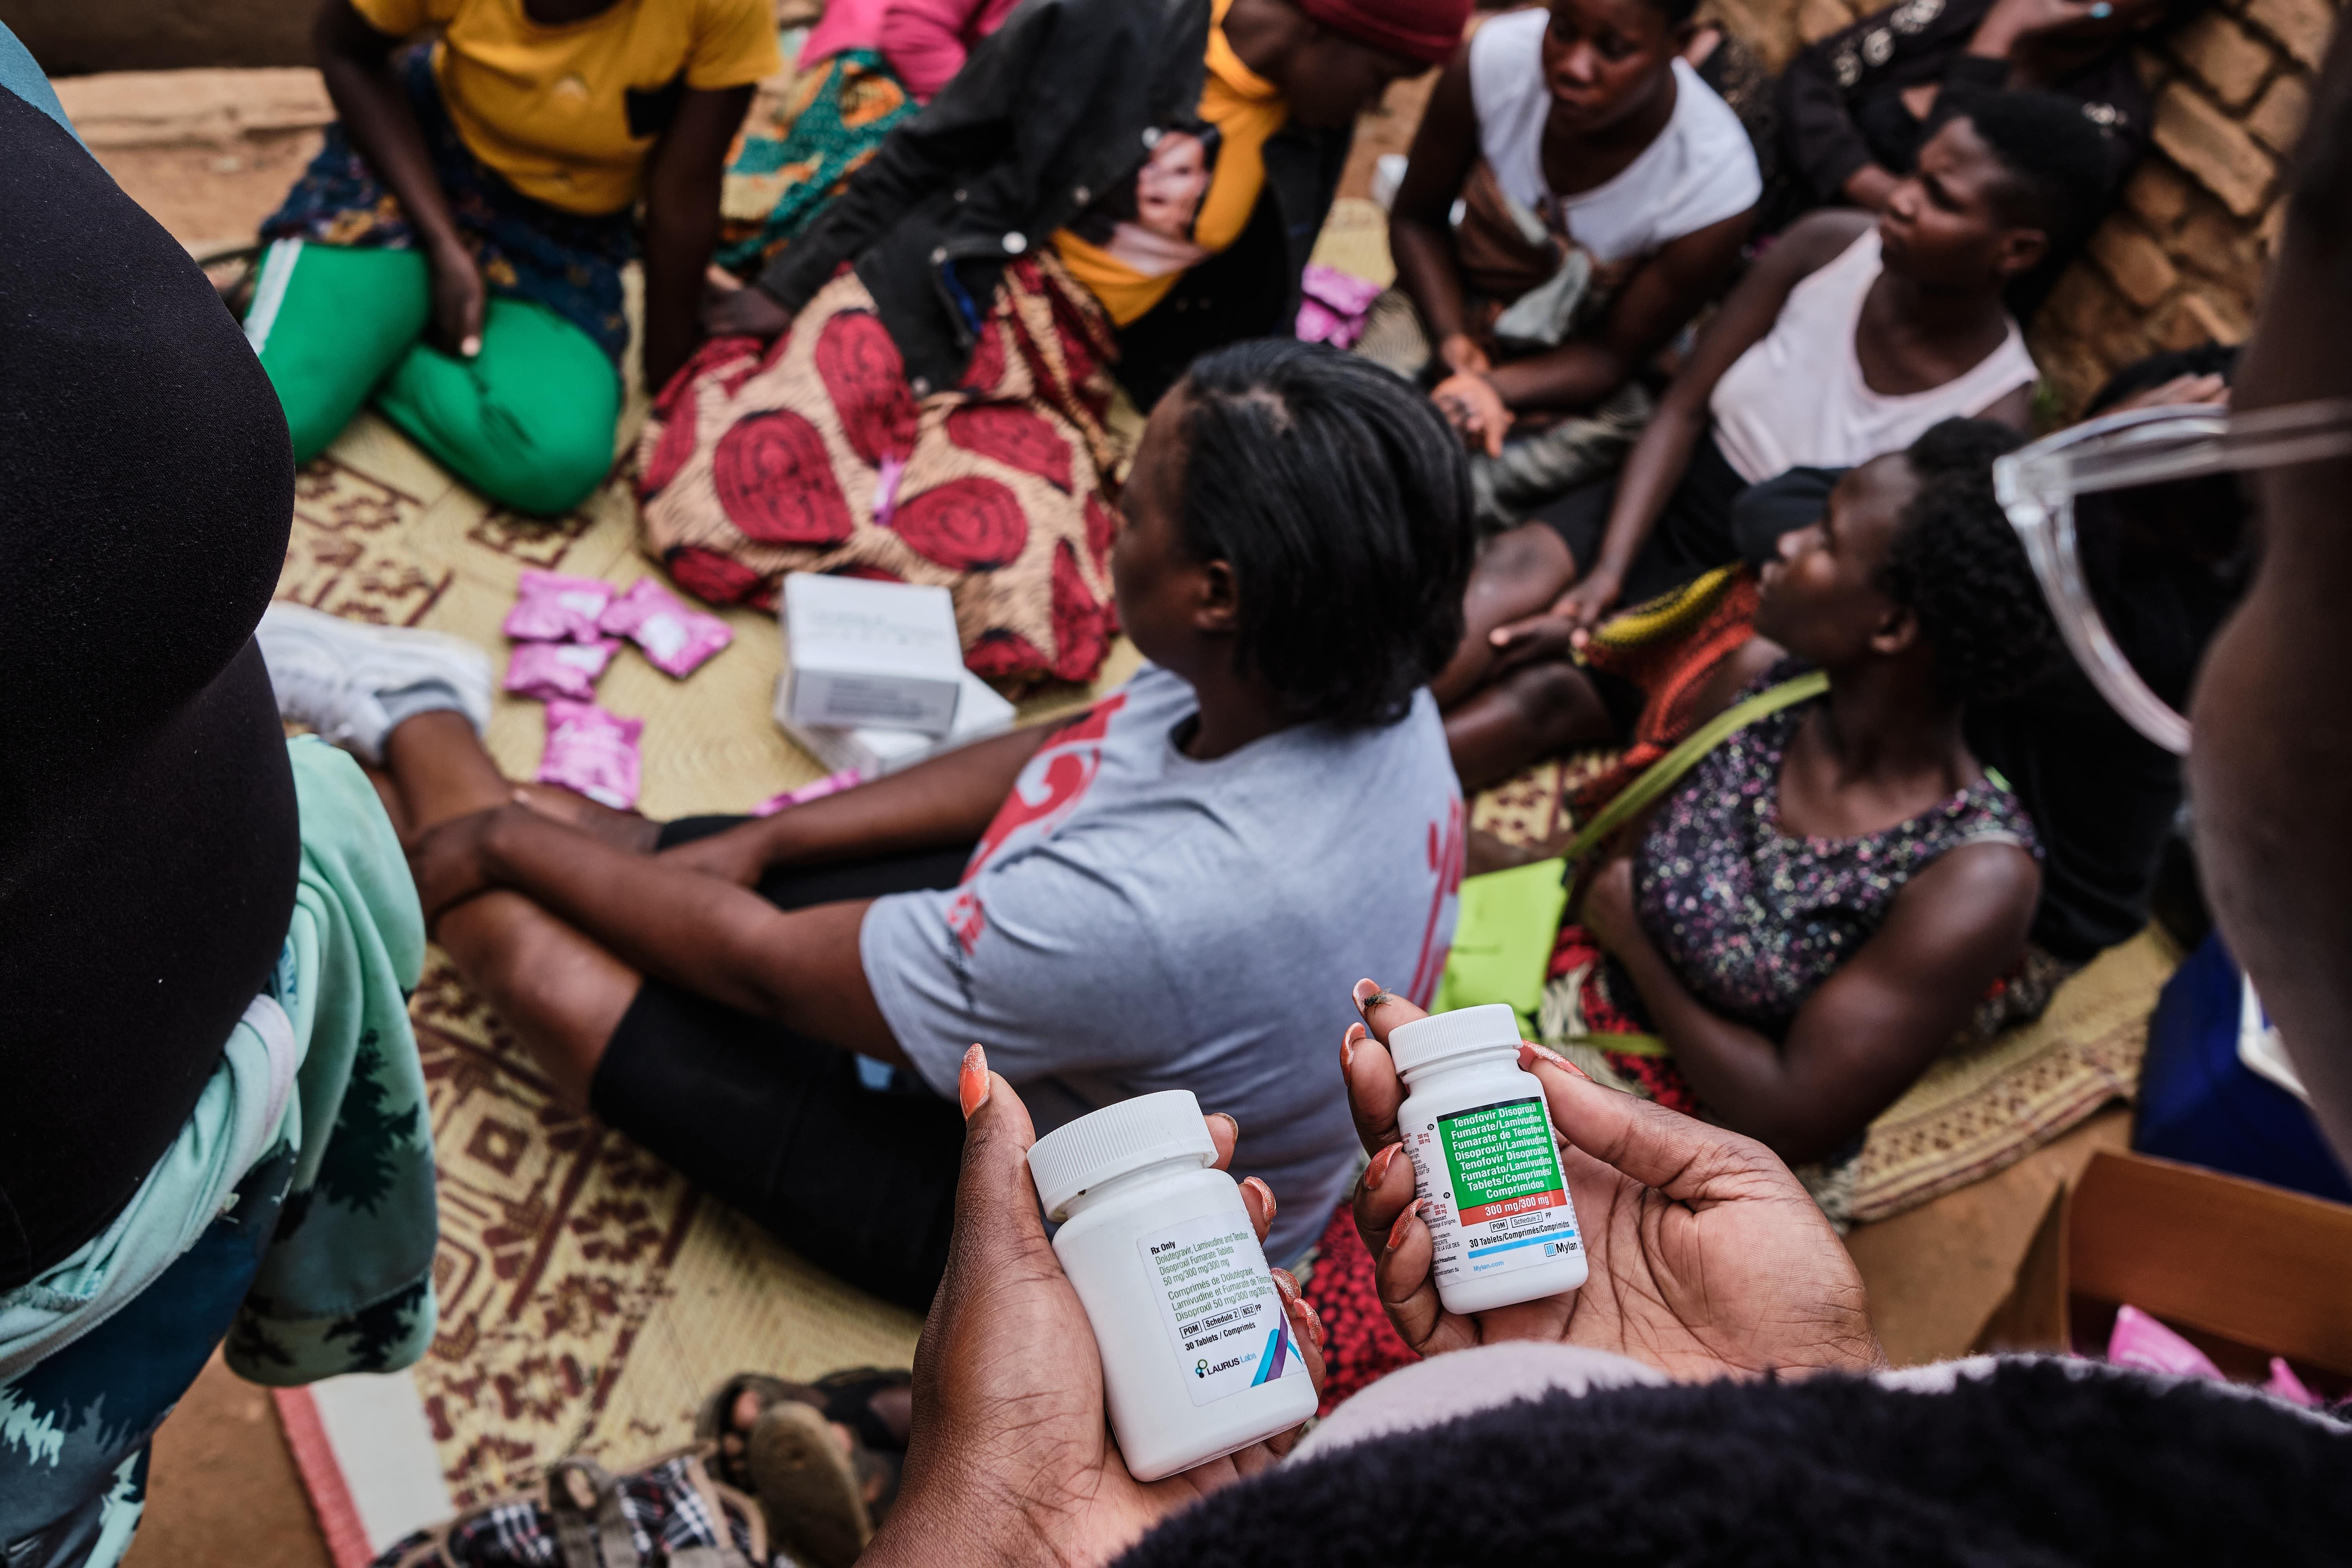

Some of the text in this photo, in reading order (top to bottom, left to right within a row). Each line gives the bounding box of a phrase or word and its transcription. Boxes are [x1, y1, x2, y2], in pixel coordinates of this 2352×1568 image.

[1451, 1114, 1542, 1140] Fumarate/Lamivudine
[1452, 1111, 1496, 1128] Tenofovir
[1498, 1103, 1537, 1118] Disoproxil
[1452, 1124, 1544, 1151] Fumarate de Ténofovir
[1455, 1135, 1548, 1161] Disoproxil/Lamivudine
[1460, 1146, 1548, 1171] Tenofovir Disoproxilo
[1461, 1156, 1552, 1182] Fumarato/Lamivudina
[1467, 1166, 1552, 1192] Tablets/Comprimés/
[1486, 1180, 1545, 1199] Comprimidos
[1485, 1195, 1550, 1216] 300 mg/300 mg
[1469, 1238, 1479, 1248] 30
[1479, 1221, 1570, 1246] Tablets/Comprimés/Comprimidos
[1492, 1222, 1505, 1230] POM
[1514, 1216, 1536, 1225] Schedule
[1156, 1231, 1249, 1265] Dolutegravir, Lamivudine and Tenofovir
[1161, 1241, 1176, 1251] Only
[1555, 1241, 1578, 1254] Mylan
[1159, 1246, 1234, 1275] Disoproxil Fumarate Tablets
[1163, 1258, 1230, 1286] 50 mg/300 mg/300 mg
[1473, 1260, 1504, 1272] Mylan.com
[1168, 1267, 1255, 1300] Comprimés de Dolutégravir,
[1172, 1290, 1214, 1311] Lamivudine
[1223, 1279, 1250, 1293] Fumarate
[1250, 1276, 1257, 1286] de
[1176, 1286, 1274, 1322] Disoproxil 50 mg/300 mg/300 mg
[1183, 1325, 1199, 1336] POM
[1205, 1314, 1233, 1327] Schedule
[1243, 1307, 1254, 1315] NS2
[1185, 1322, 1256, 1351] 30 Tablets / Comprimés
[1207, 1353, 1257, 1375] LAURUS Labs
